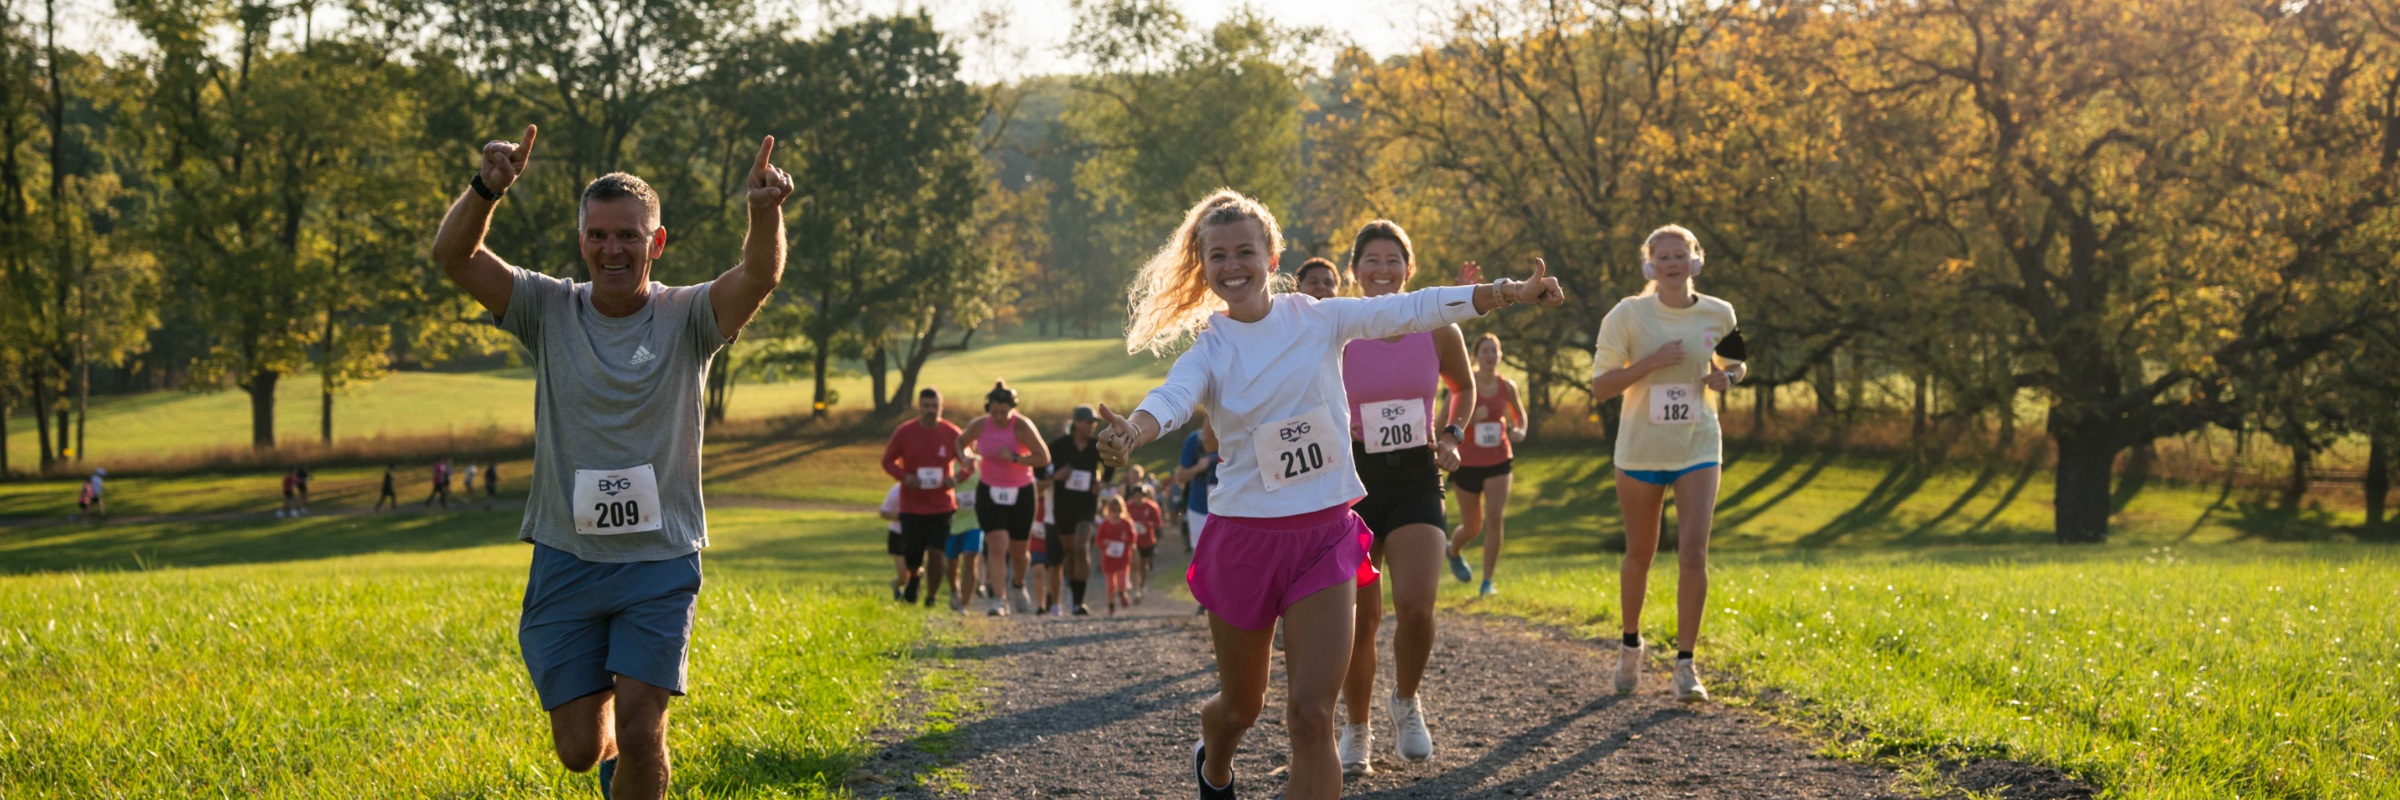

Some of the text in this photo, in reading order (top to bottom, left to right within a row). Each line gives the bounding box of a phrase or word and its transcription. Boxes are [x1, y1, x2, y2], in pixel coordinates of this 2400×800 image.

[631, 353, 656, 365] adidas
[1382, 406, 1405, 417] BMG
[1664, 404, 1689, 420] 182
[1280, 422, 1311, 440] BMG
[1379, 423, 1413, 447] 208
[1280, 442, 1324, 479] 210
[598, 478, 631, 491] BMG
[594, 500, 639, 528] 209
